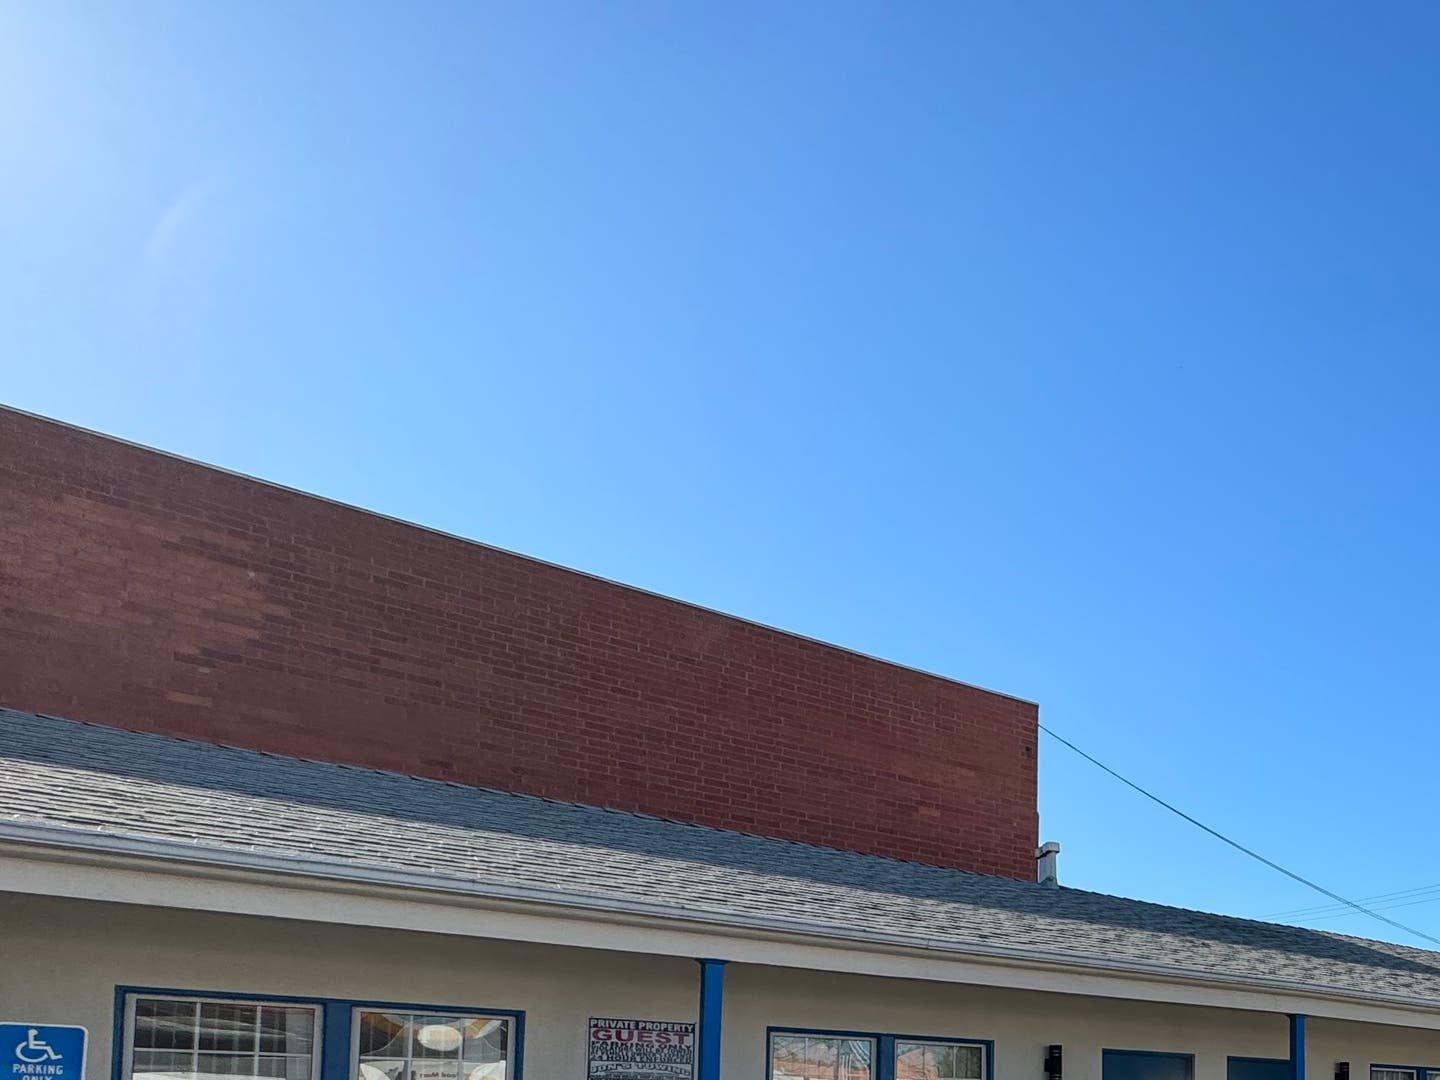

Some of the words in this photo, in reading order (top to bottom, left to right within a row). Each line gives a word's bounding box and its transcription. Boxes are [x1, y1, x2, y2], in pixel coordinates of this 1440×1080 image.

[590, 1019, 636, 1030] PRIVATE
[638, 1021, 694, 1032] PROPERTY
[592, 1029, 690, 1045] GUEST
[12, 1063, 64, 1075] PARKING
